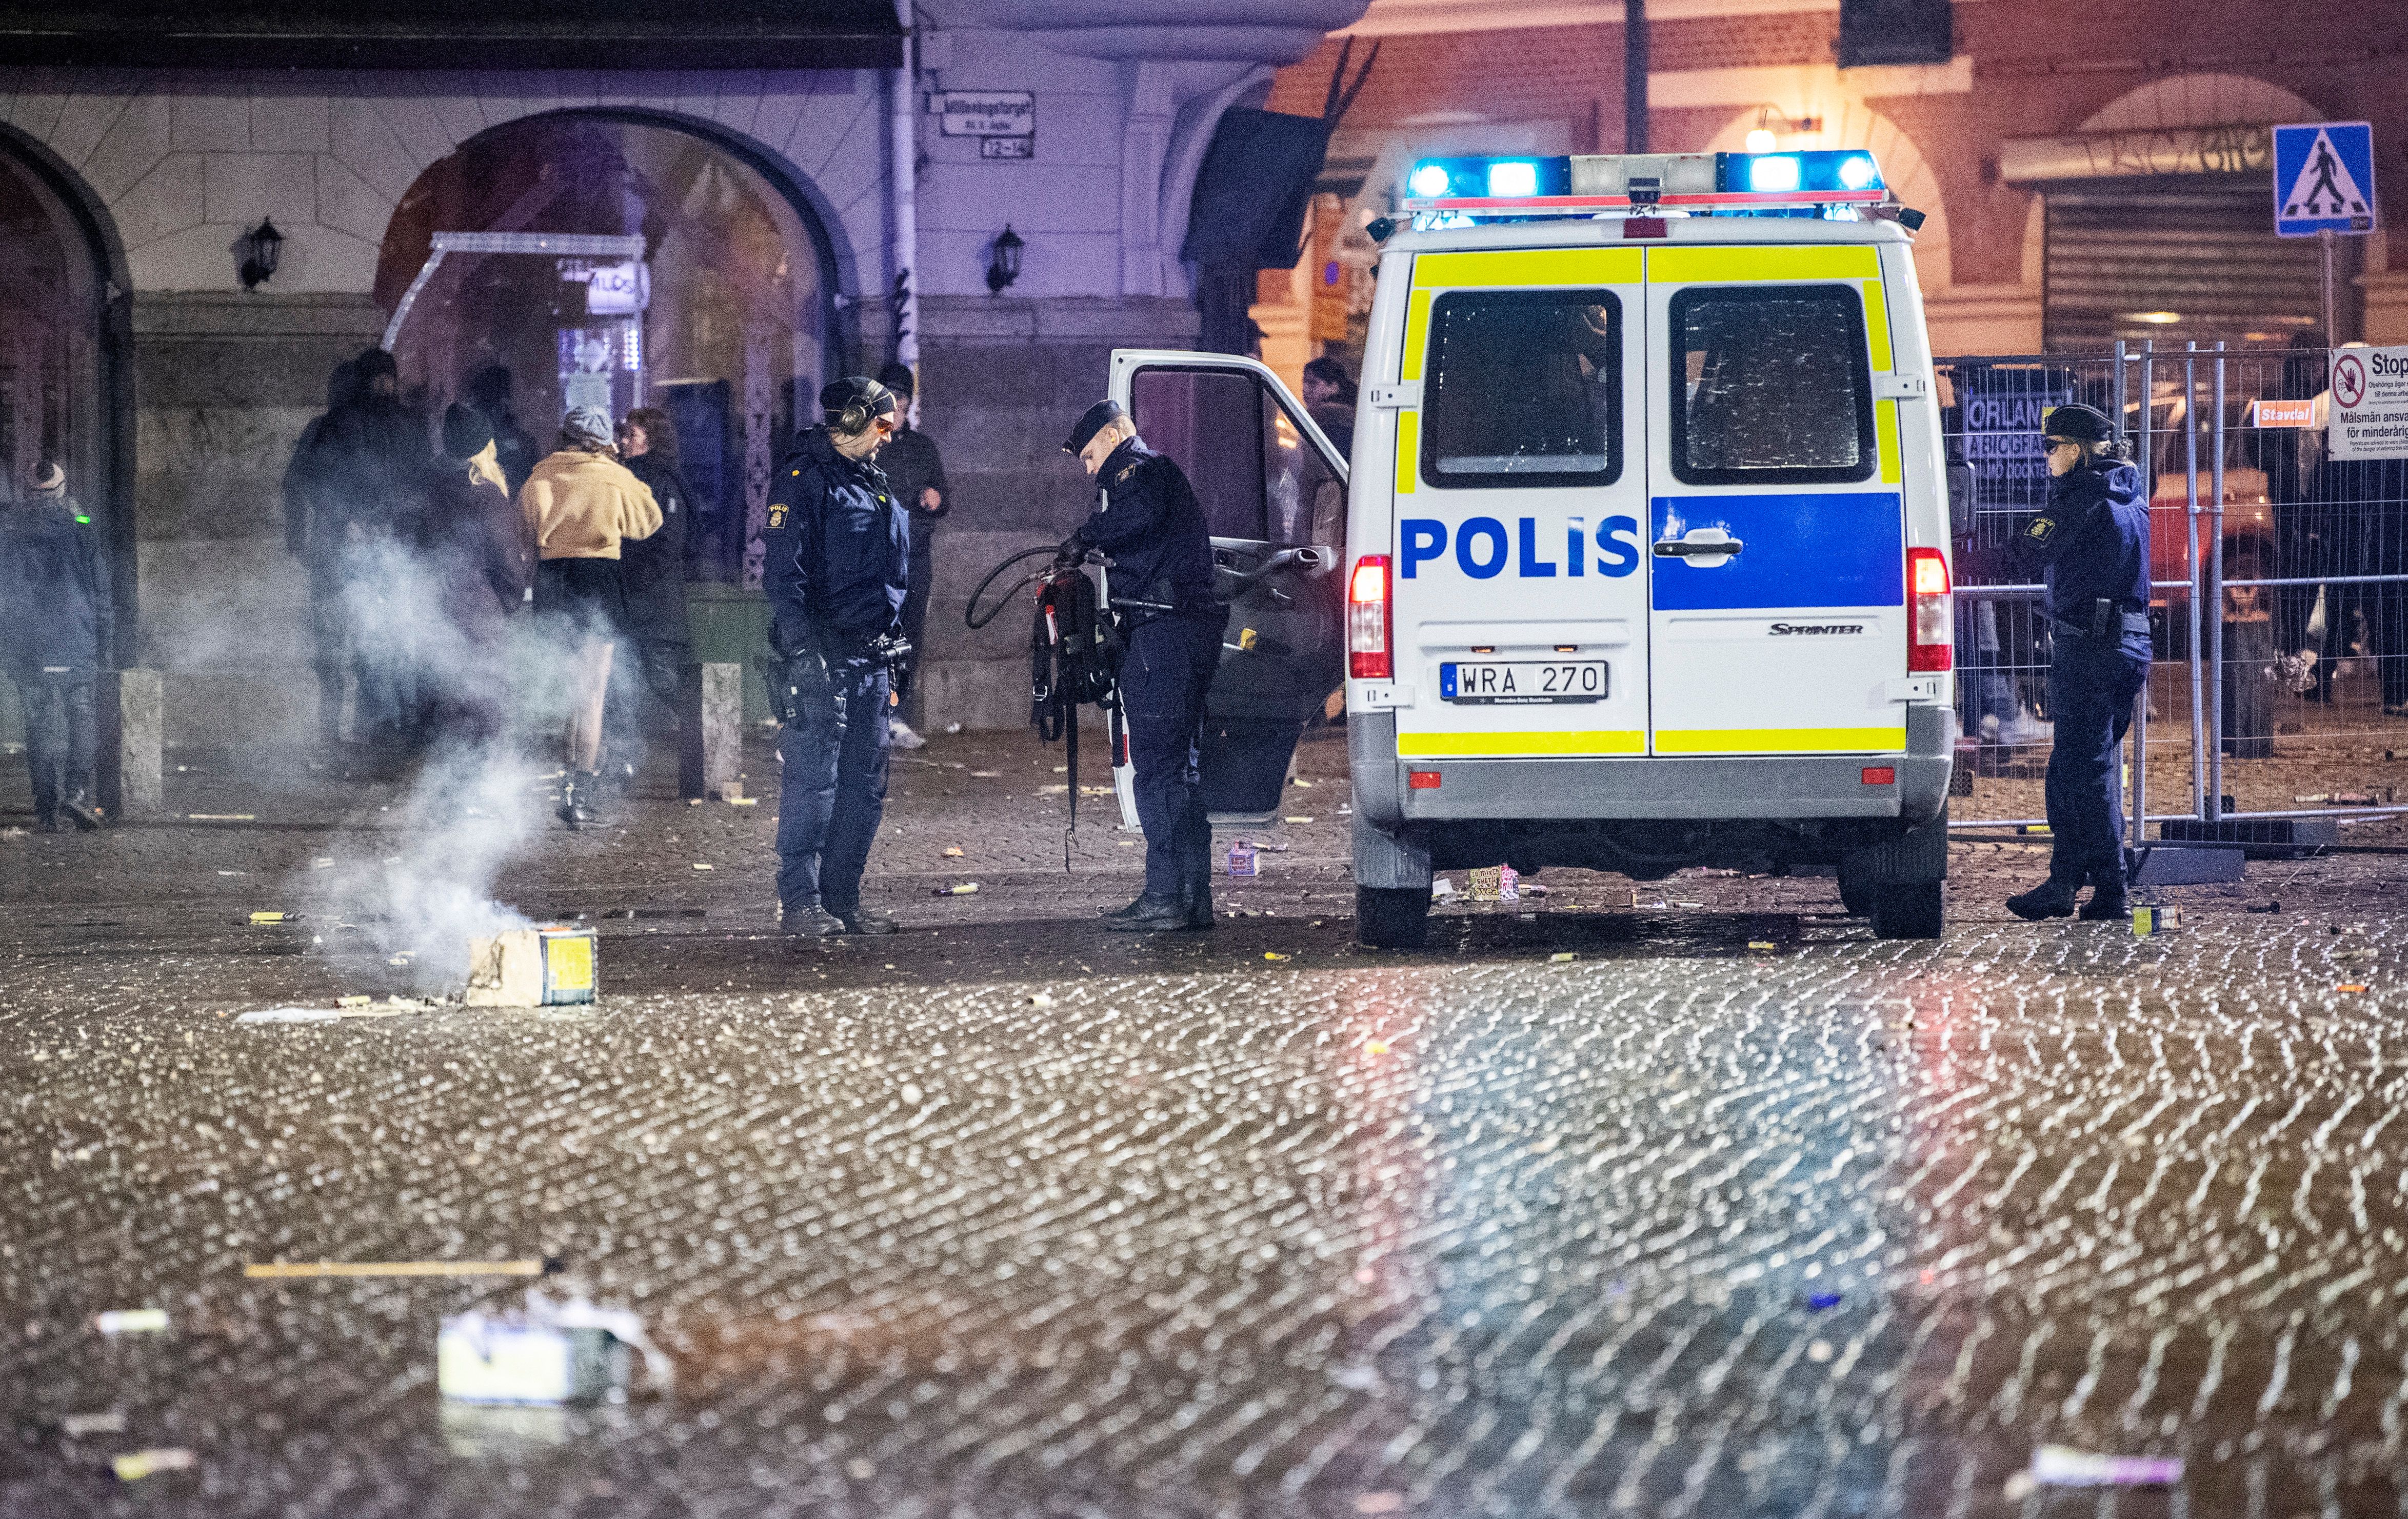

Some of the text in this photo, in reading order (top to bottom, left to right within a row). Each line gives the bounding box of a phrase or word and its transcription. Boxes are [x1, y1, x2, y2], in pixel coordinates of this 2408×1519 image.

[1968, 399, 2064, 428] ORLAN
[2261, 408, 2310, 421] Stavdal
[2341, 411, 2381, 424] Målsmän
[2347, 427, 2360, 438] för
[1401, 515, 1639, 578] POLIS
[1769, 623, 1863, 636] SPRINTER
[1462, 667, 1598, 692] WRA 270
[1447, 684, 1452, 692] S
[1475, 885, 1500, 896] Svea
